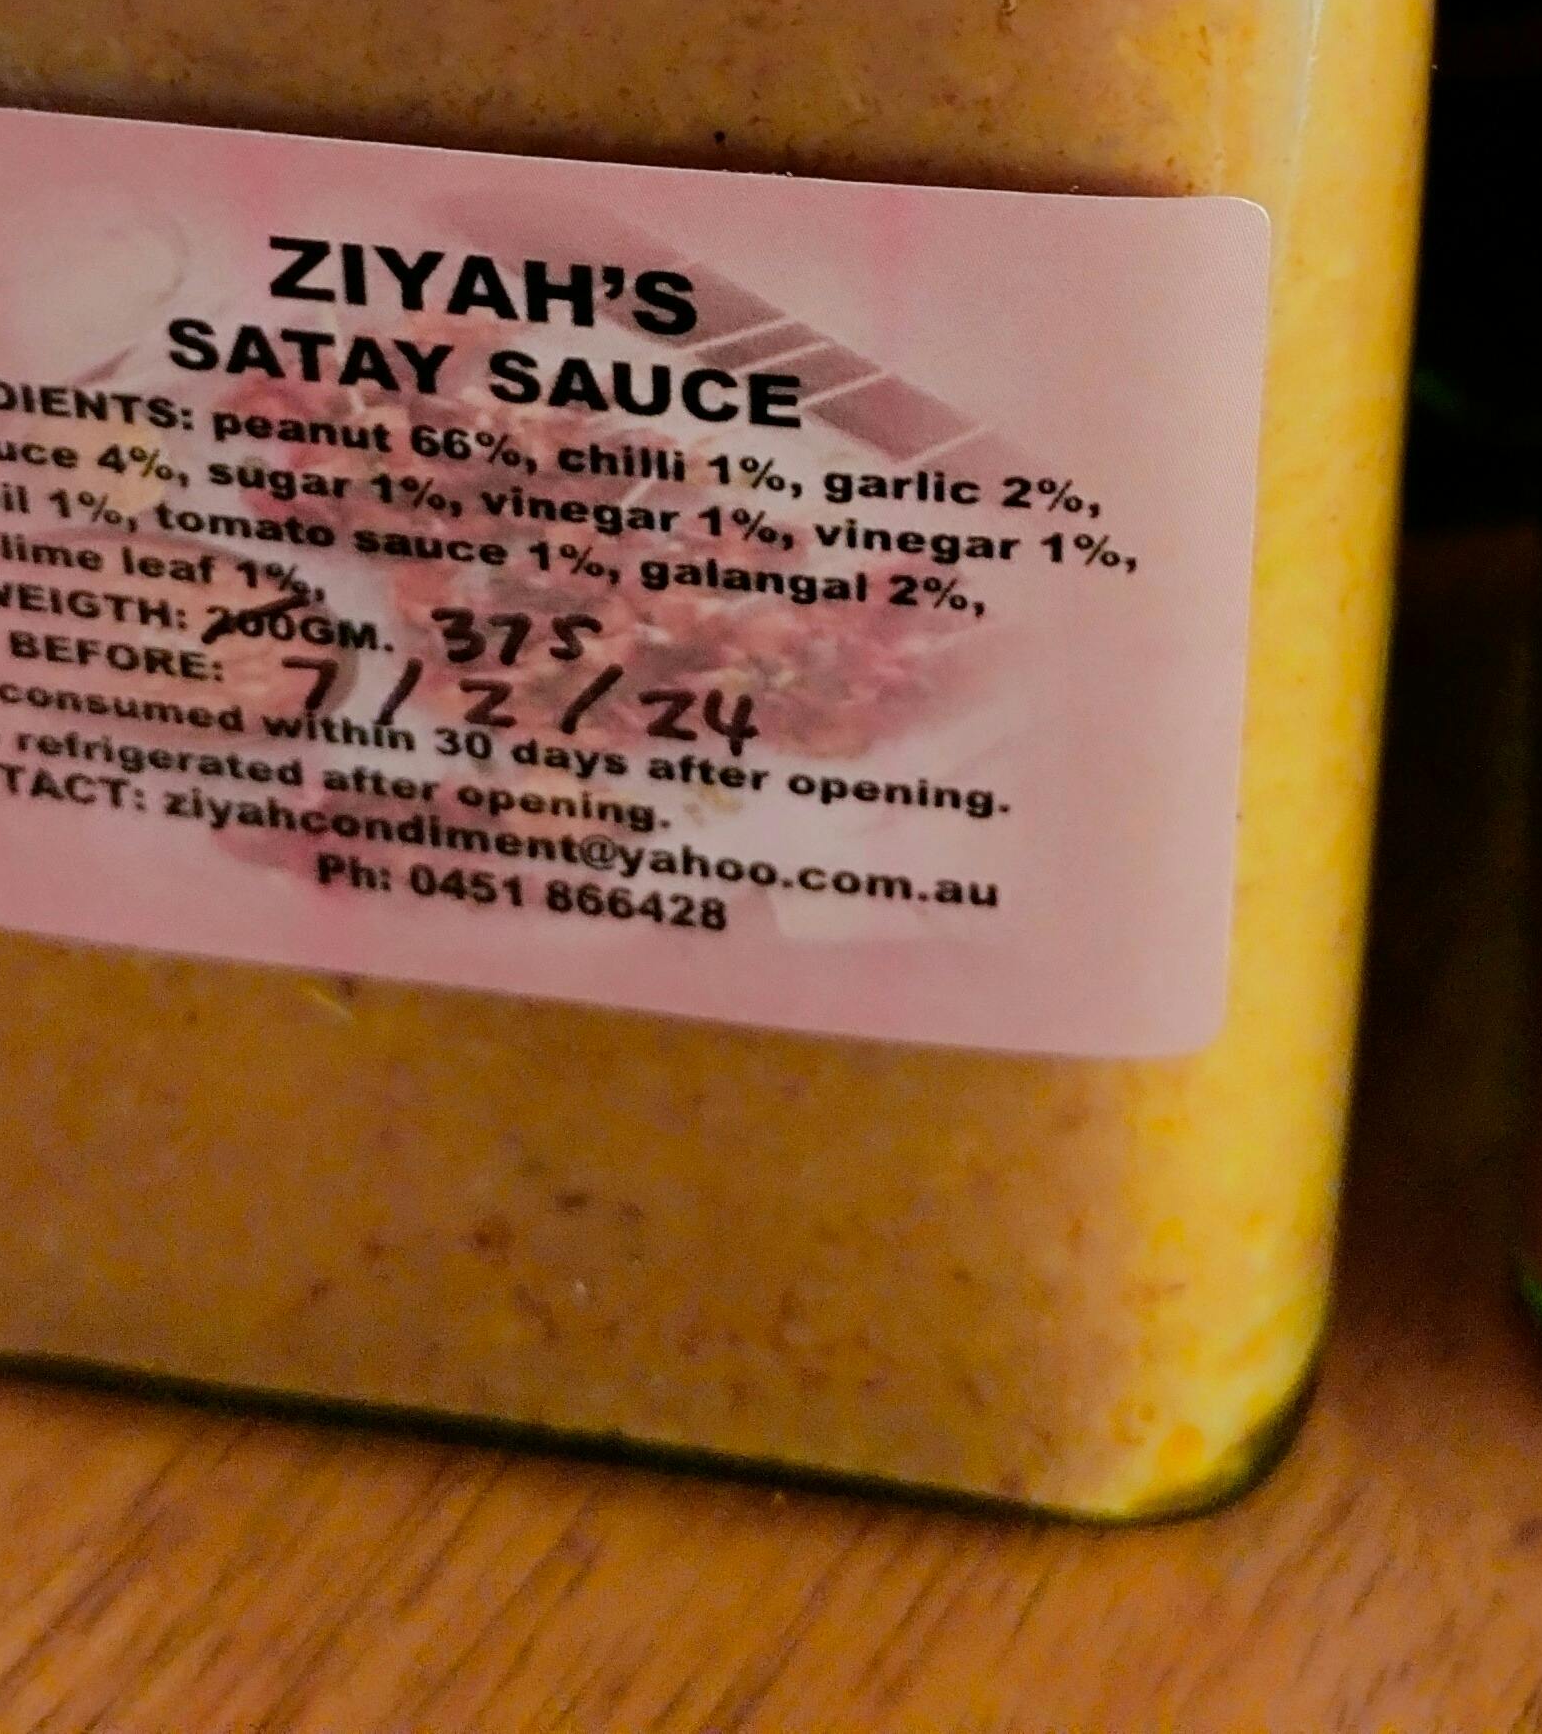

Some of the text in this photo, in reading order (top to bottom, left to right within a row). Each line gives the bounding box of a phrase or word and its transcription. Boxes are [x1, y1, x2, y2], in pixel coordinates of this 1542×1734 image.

[269, 236, 697, 336] ZIYAH'S
[168, 318, 801, 427] SATAY SAUCE
[97, 444, 189, 489] 4%,
[208, 462, 350, 501] sugar
[371, 470, 463, 517] 1%,
[482, 488, 679, 536] vinegar
[700, 508, 794, 550] 1%,
[813, 519, 1021, 564] vinegar
[1040, 533, 1137, 573] 1%,
[212, 409, 390, 452] peanut
[410, 426, 538, 474] 66%,
[556, 443, 685, 481] chilli
[708, 454, 802, 498] 1%,
[824, 468, 978, 506] garlic
[1002, 476, 1100, 519] 2%,
[0, 531, 103, 571] lime
[123, 545, 218, 584] leaf
[50, 489, 137, 533] 1%,
[156, 501, 335, 548] tomato
[355, 529, 507, 565] sauce
[529, 542, 621, 585] 1%,
[639, 558, 867, 603] galangal
[888, 574, 986, 616] 2%,
[9, 630, 223, 682] BEFORE:
[431, 608, 602, 664] 375
[18, 725, 304, 787] refrigerated
[323, 765, 440, 802] after
[458, 784, 671, 833] opening.
[263, 712, 416, 752] within
[436, 728, 493, 761] 30
[512, 736, 628, 779] days
[649, 754, 769, 791] after
[788, 773, 1011, 819] opening.
[164, 788, 1000, 908] ziyahcondiment@yahoo.com.au
[316, 853, 727, 933] Ph: 0451 866428
